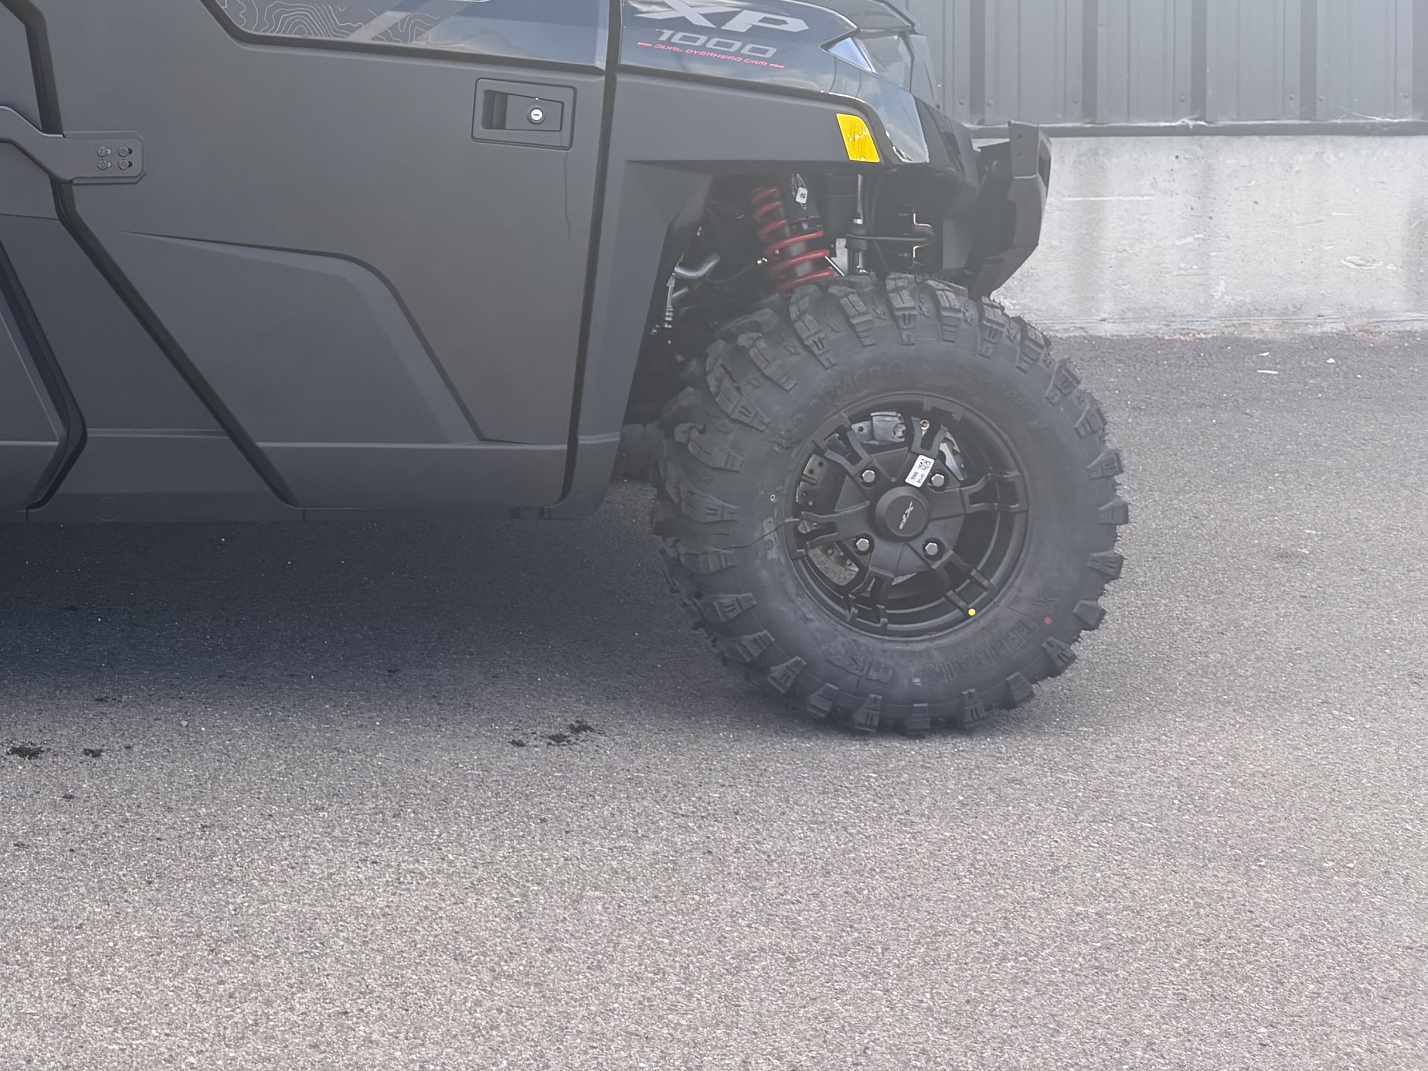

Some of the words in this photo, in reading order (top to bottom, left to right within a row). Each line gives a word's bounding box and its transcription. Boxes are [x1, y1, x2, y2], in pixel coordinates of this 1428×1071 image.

[653, 44, 683, 53] DUAL
[743, 57, 769, 67] CAM
[656, 28, 778, 59] 1000
[898, 501, 915, 530] XP
